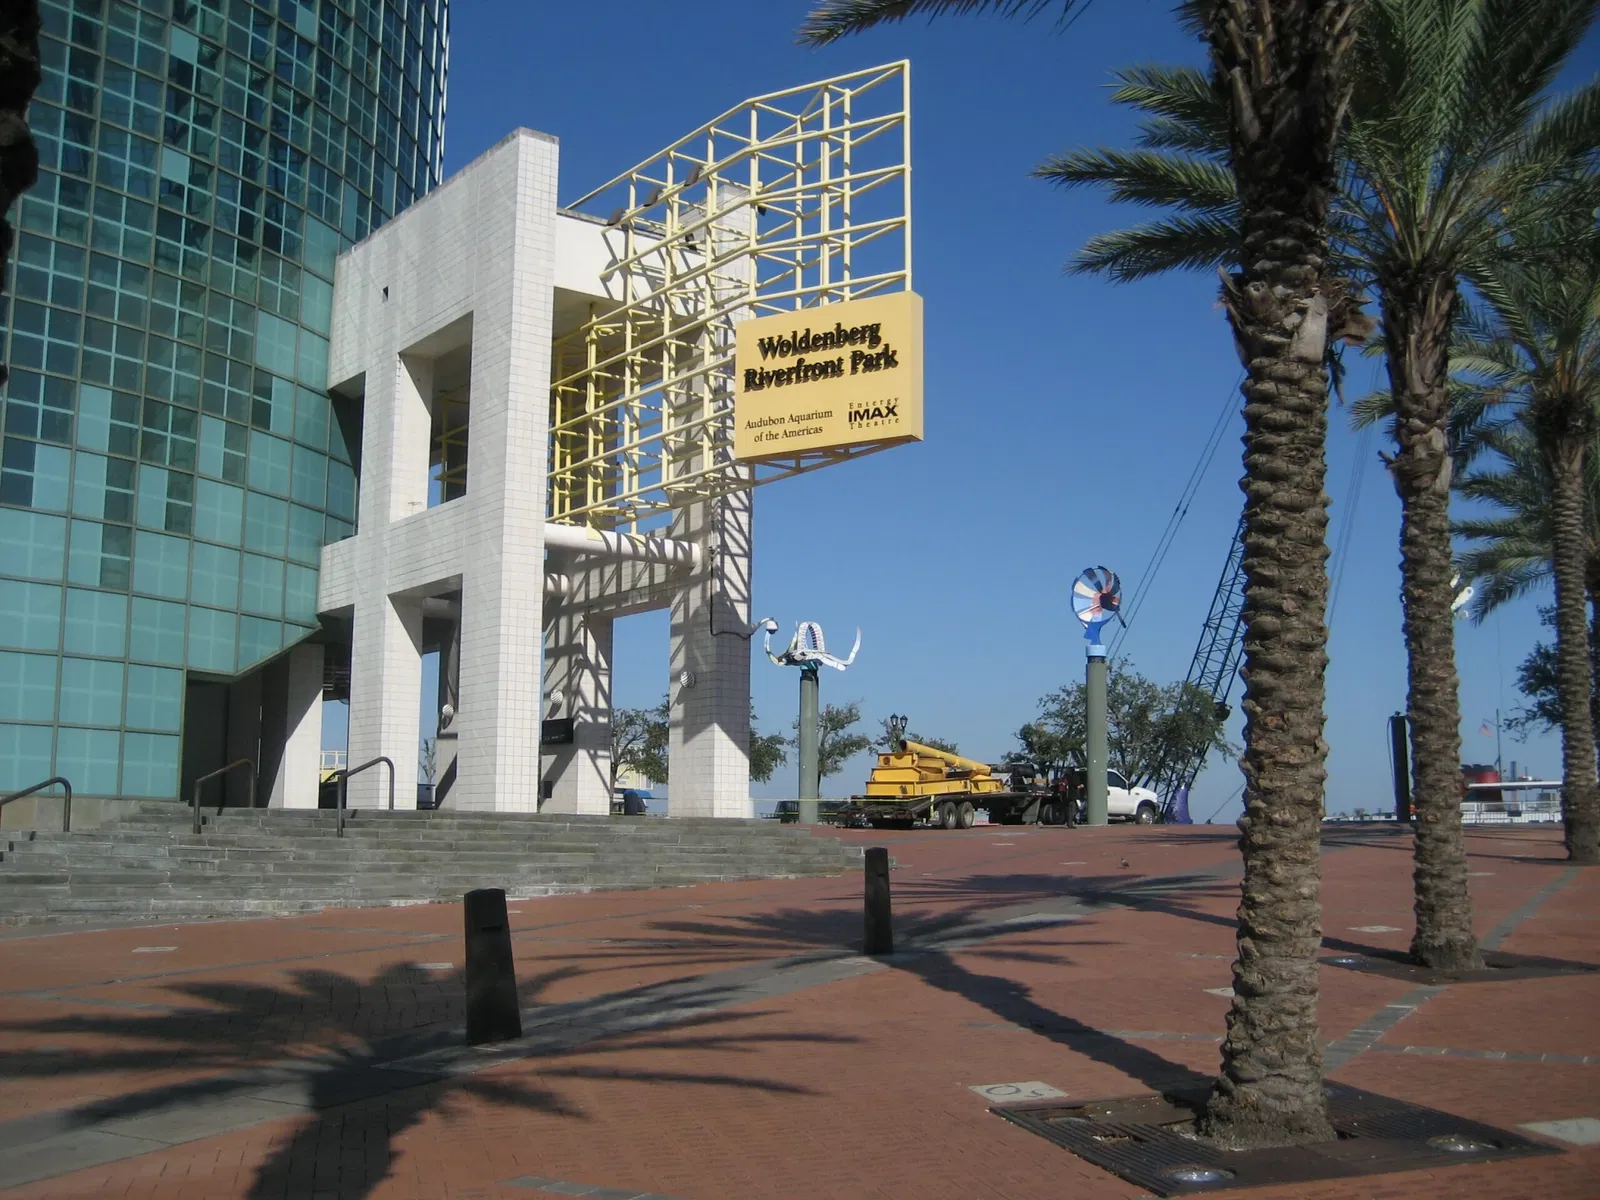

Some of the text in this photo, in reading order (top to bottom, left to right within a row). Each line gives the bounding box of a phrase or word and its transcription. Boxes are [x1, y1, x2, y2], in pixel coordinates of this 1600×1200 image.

[758, 322, 881, 360] Woldenberg
[743, 343, 898, 392] Riverfront Park
[849, 397, 899, 409] Entergy
[744, 409, 833, 430] Audubon Aquarium
[848, 405, 898, 423] IMAX
[849, 418, 899, 430] Theatre
[754, 426, 823, 443] of the Americas
